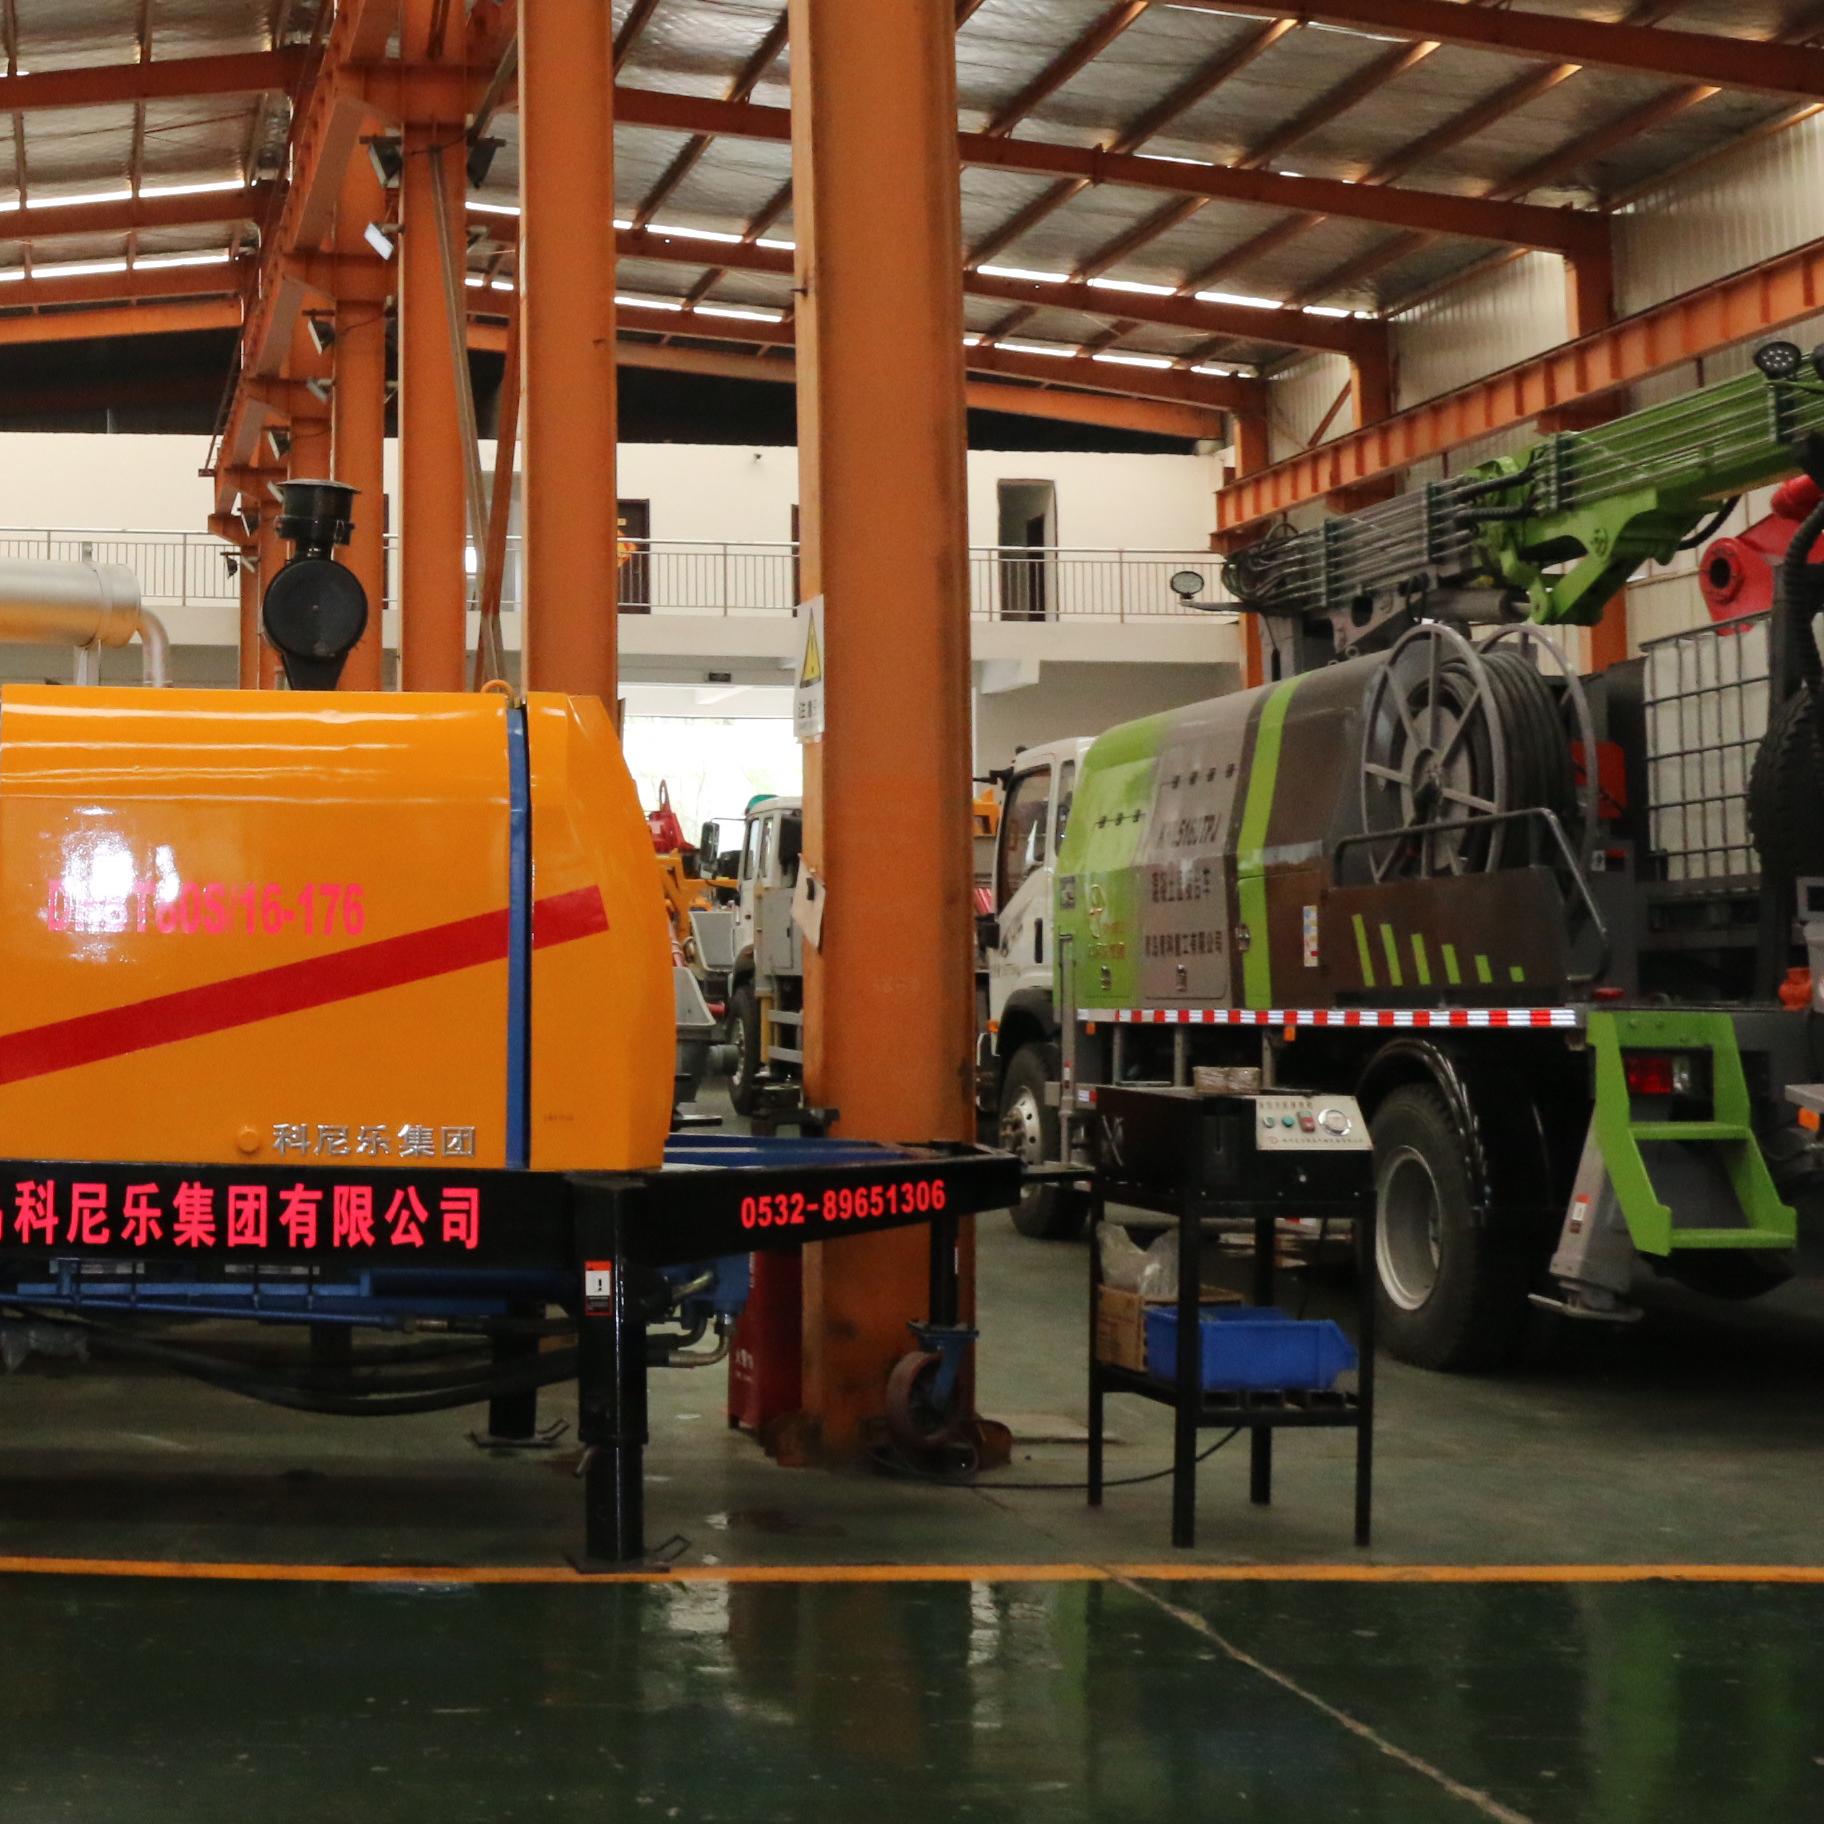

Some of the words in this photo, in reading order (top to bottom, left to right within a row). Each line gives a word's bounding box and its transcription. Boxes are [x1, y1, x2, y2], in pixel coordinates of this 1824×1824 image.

[272, 1123, 476, 1158] 科尼乐集团
[740, 1179, 946, 1229] 0532-89651306
